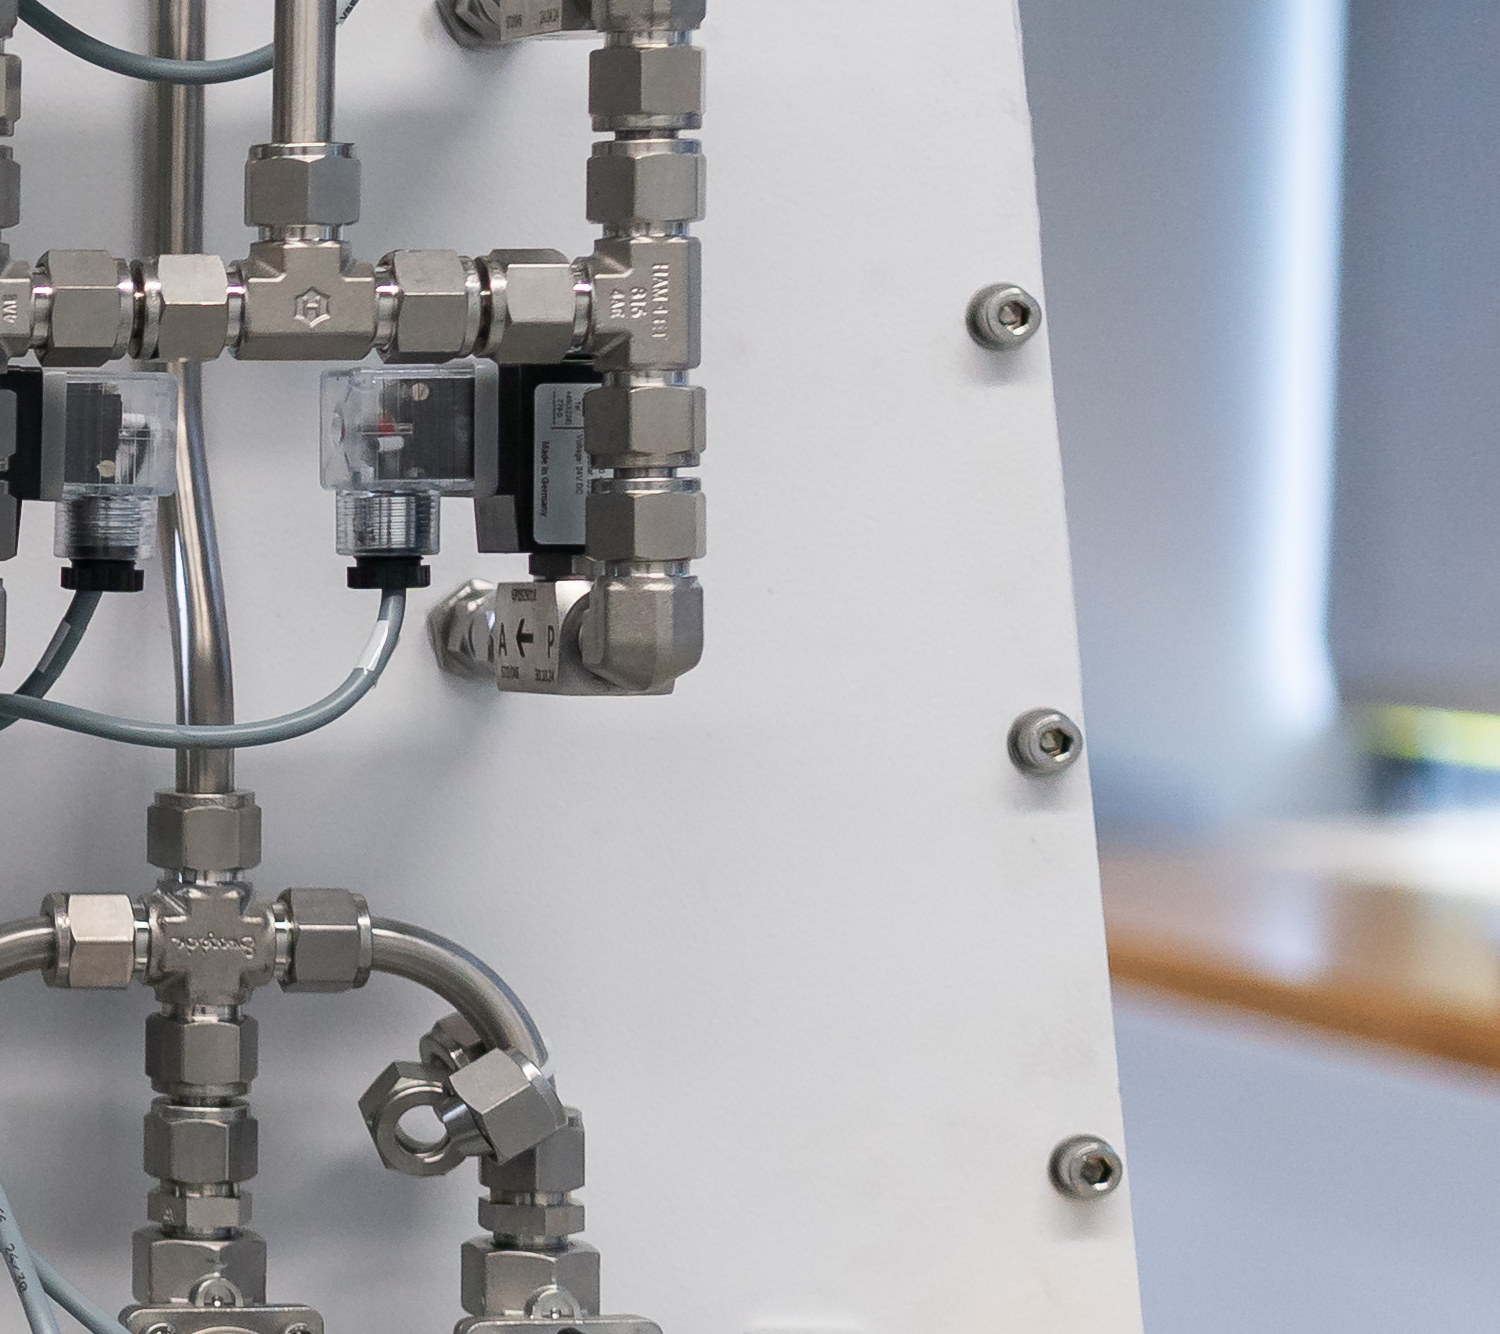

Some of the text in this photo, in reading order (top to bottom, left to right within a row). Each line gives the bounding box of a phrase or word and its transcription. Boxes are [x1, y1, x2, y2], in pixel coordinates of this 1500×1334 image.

[542, 441, 550, 464] Made
[540, 477, 550, 517] Germany
[499, 622, 555, 658] A P
